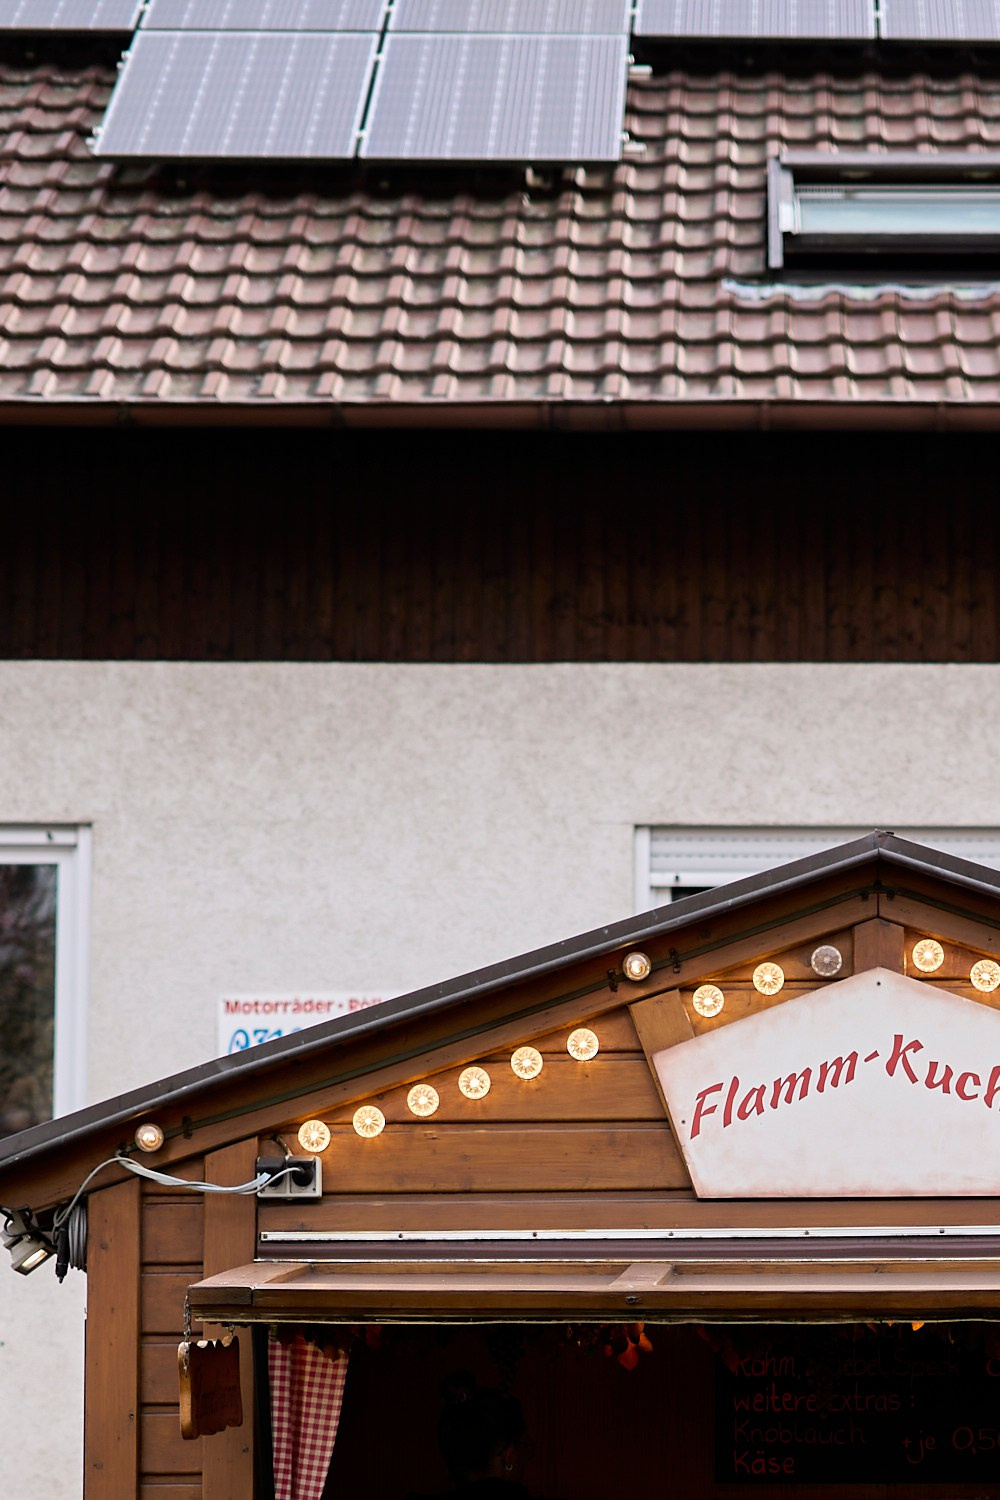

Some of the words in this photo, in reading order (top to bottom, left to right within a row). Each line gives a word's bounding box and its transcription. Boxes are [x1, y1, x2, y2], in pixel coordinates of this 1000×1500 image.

[225, 997, 334, 1014] Motorräder
[733, 1416, 869, 1445] Knoblauch
[732, 1447, 797, 1475] Käse
